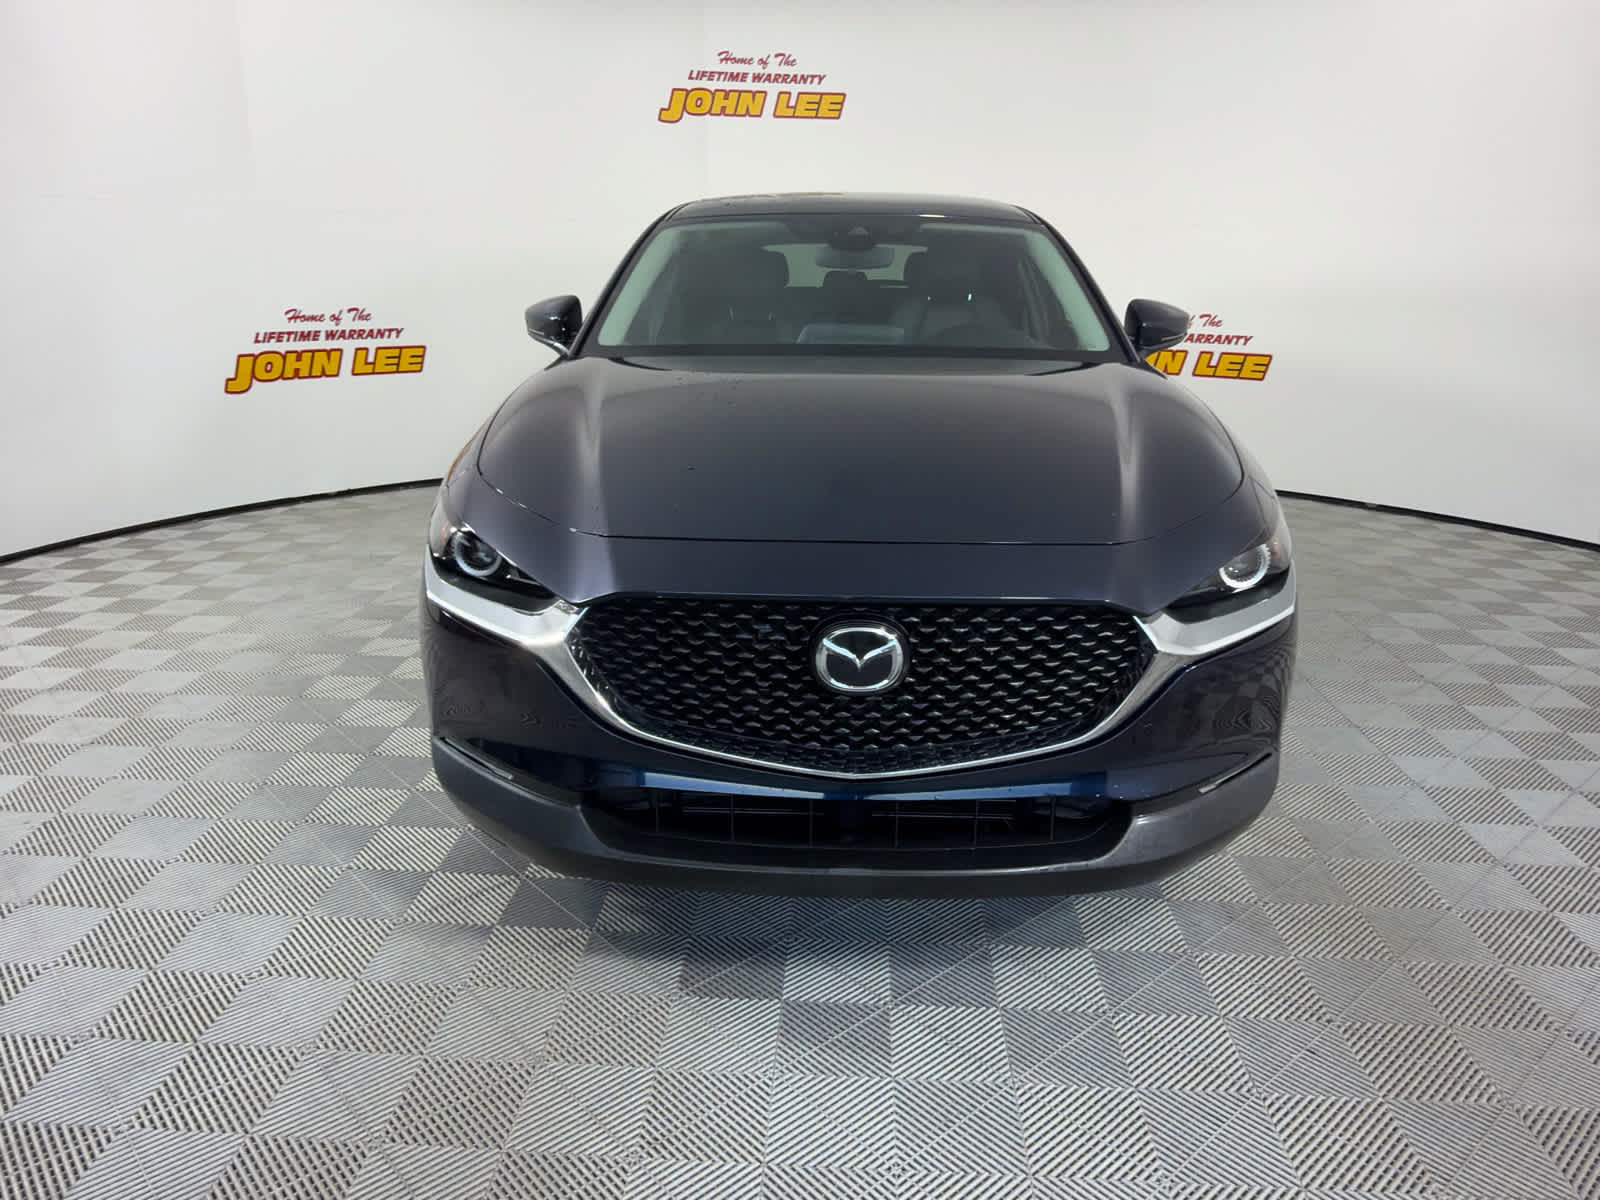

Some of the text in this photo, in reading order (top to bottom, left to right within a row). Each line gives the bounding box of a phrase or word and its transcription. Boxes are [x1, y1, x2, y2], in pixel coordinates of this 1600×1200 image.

[717, 51, 797, 70] Home of The
[688, 70, 826, 85] LIFETIME WARRANTY
[658, 88, 846, 123] JOHN LEE
[284, 307, 373, 326] Home of The
[1199, 314, 1223, 327] The
[254, 328, 404, 344] LIFETIME WARRANTY
[1184, 333, 1253, 346] ARRANTY
[224, 345, 426, 394] JOHN LEE
[1192, 351, 1272, 381] LEE
